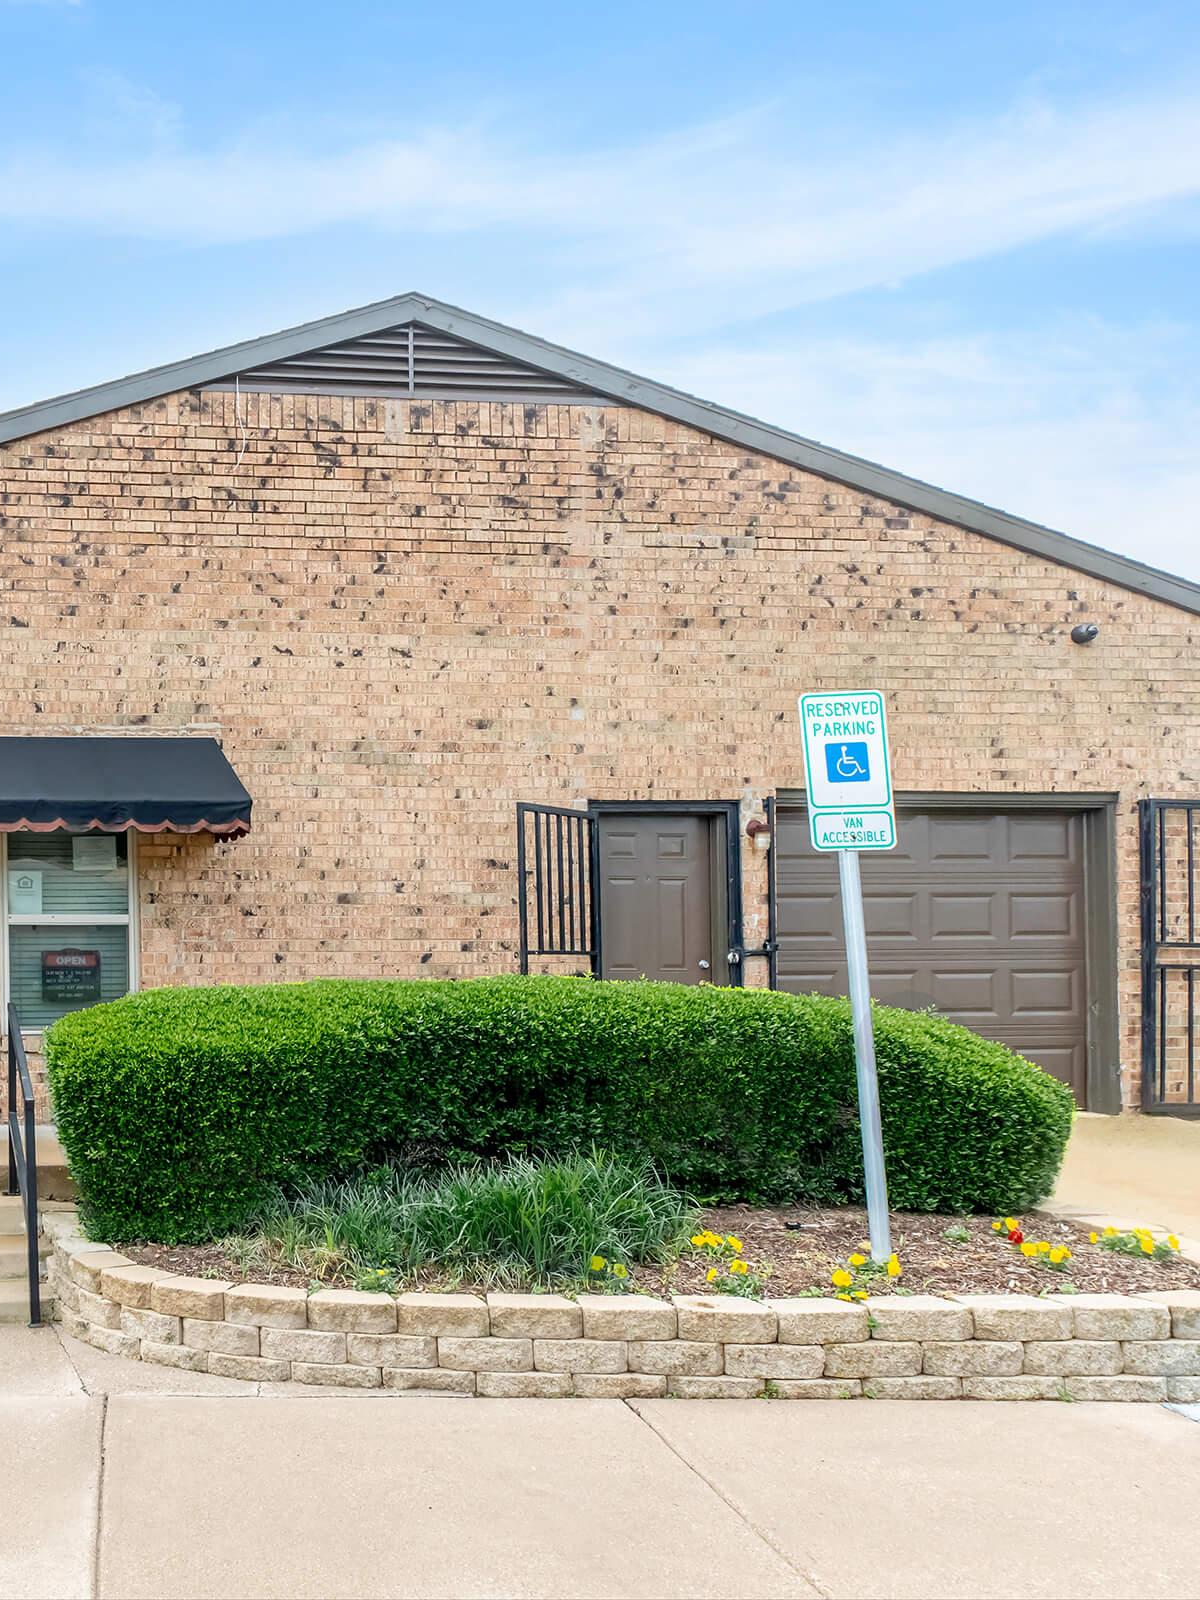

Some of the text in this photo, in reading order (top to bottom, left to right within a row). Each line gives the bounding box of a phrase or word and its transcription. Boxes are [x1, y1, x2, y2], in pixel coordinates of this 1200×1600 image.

[806, 701, 879, 718] RESERVED
[812, 720, 875, 737] PARKING
[843, 817, 863, 829] VAN
[822, 830, 887, 843] ACCESSIBLE
[56, 956, 86, 965] OPEN
